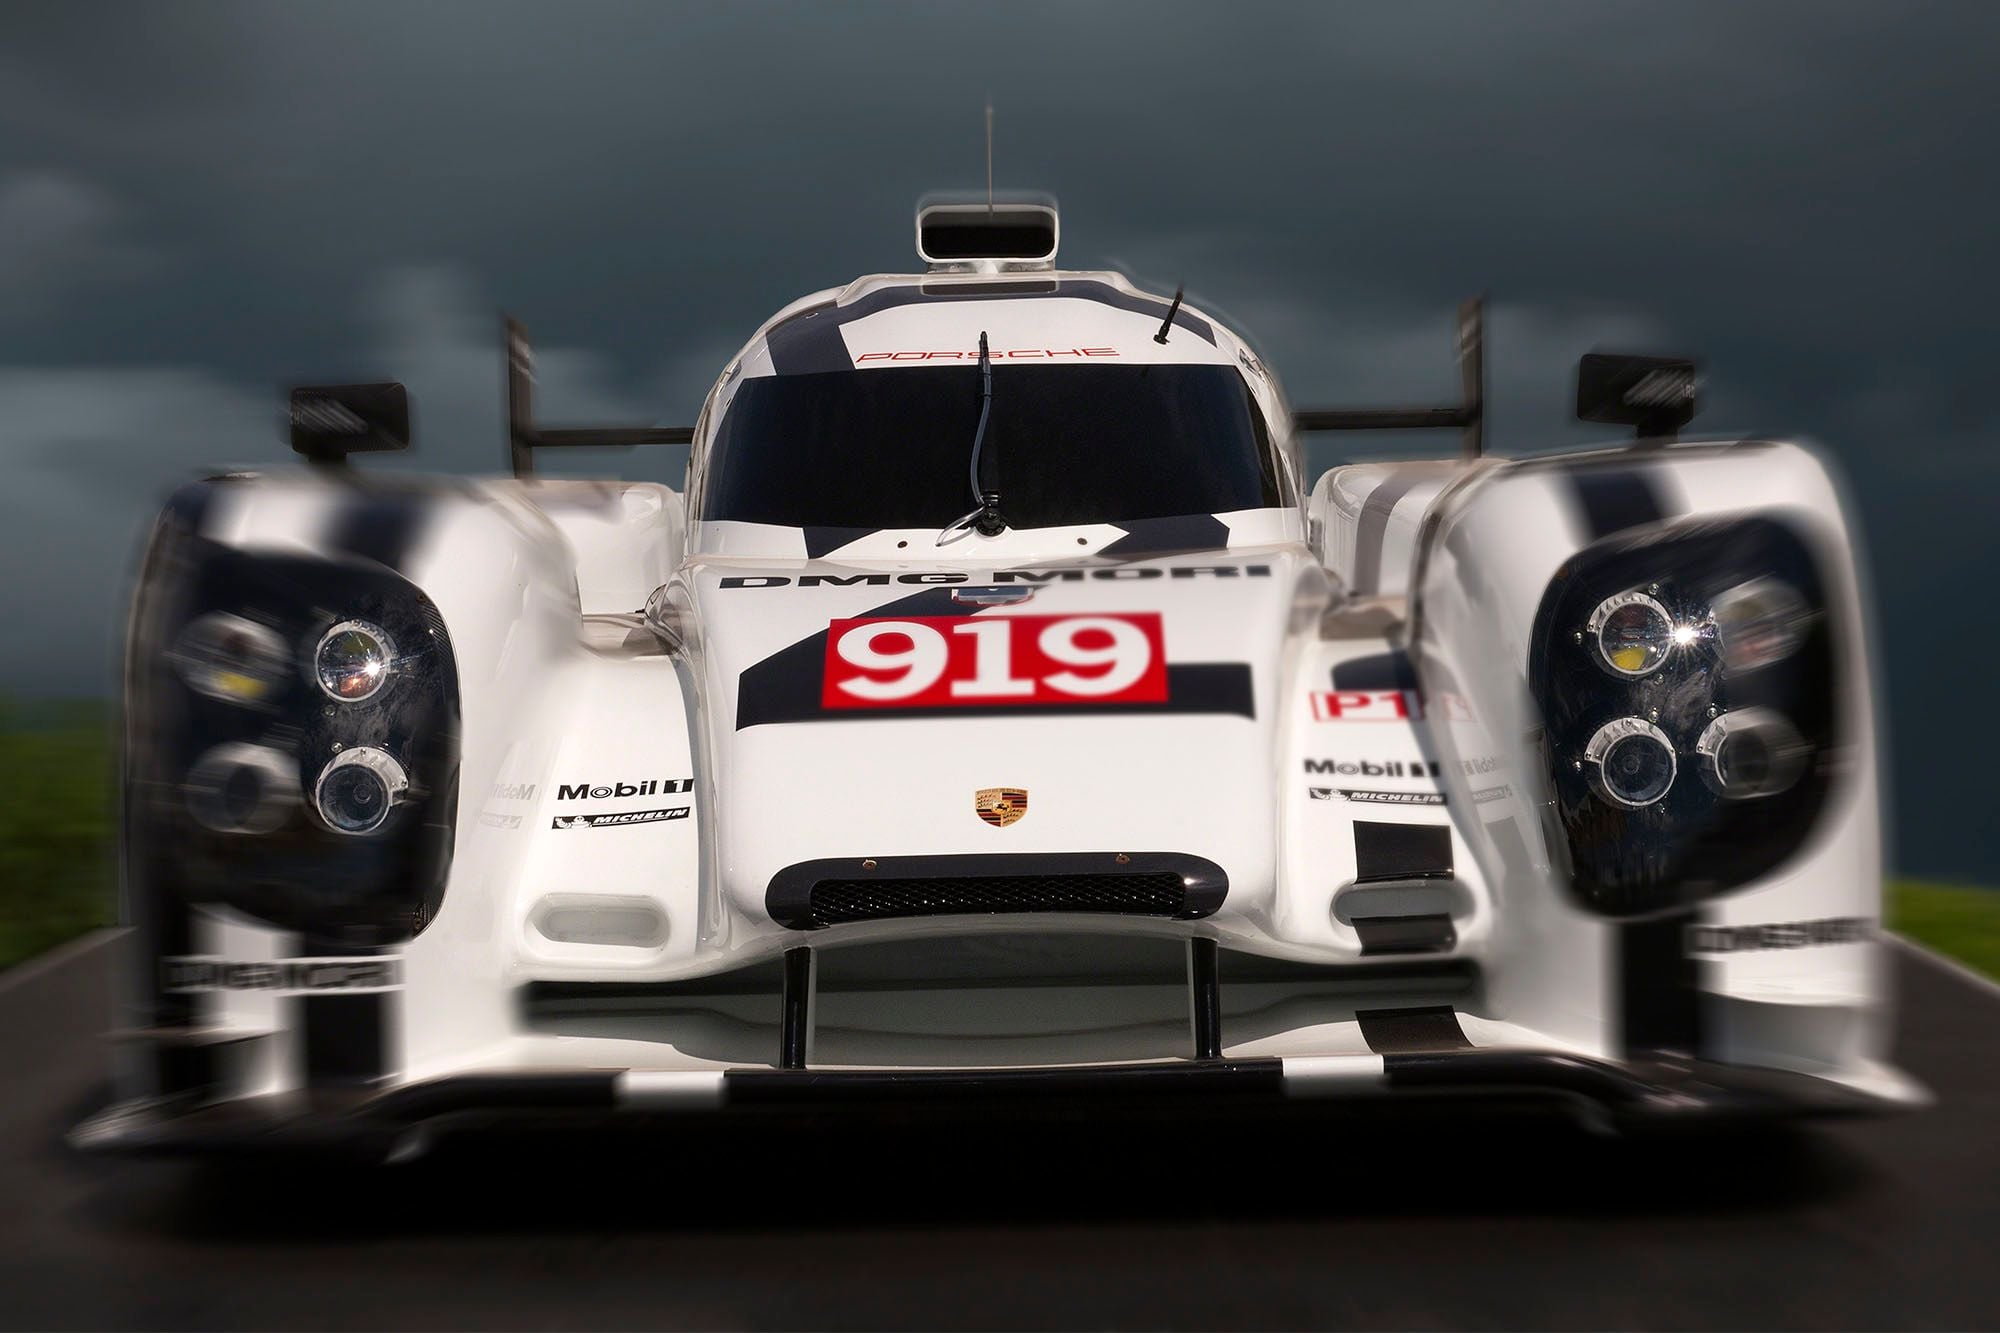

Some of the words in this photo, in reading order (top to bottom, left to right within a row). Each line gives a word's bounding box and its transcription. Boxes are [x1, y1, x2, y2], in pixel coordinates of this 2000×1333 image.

[856, 347, 1120, 363] PORSCHE
[719, 572, 969, 589] DMG
[993, 565, 1271, 584] MORI
[836, 617, 1152, 701] 919
[1303, 759, 1403, 778] Mobil
[557, 780, 657, 801] Mobil
[1351, 790, 1444, 804] MICHELIN
[593, 808, 688, 825] MICHELIN
